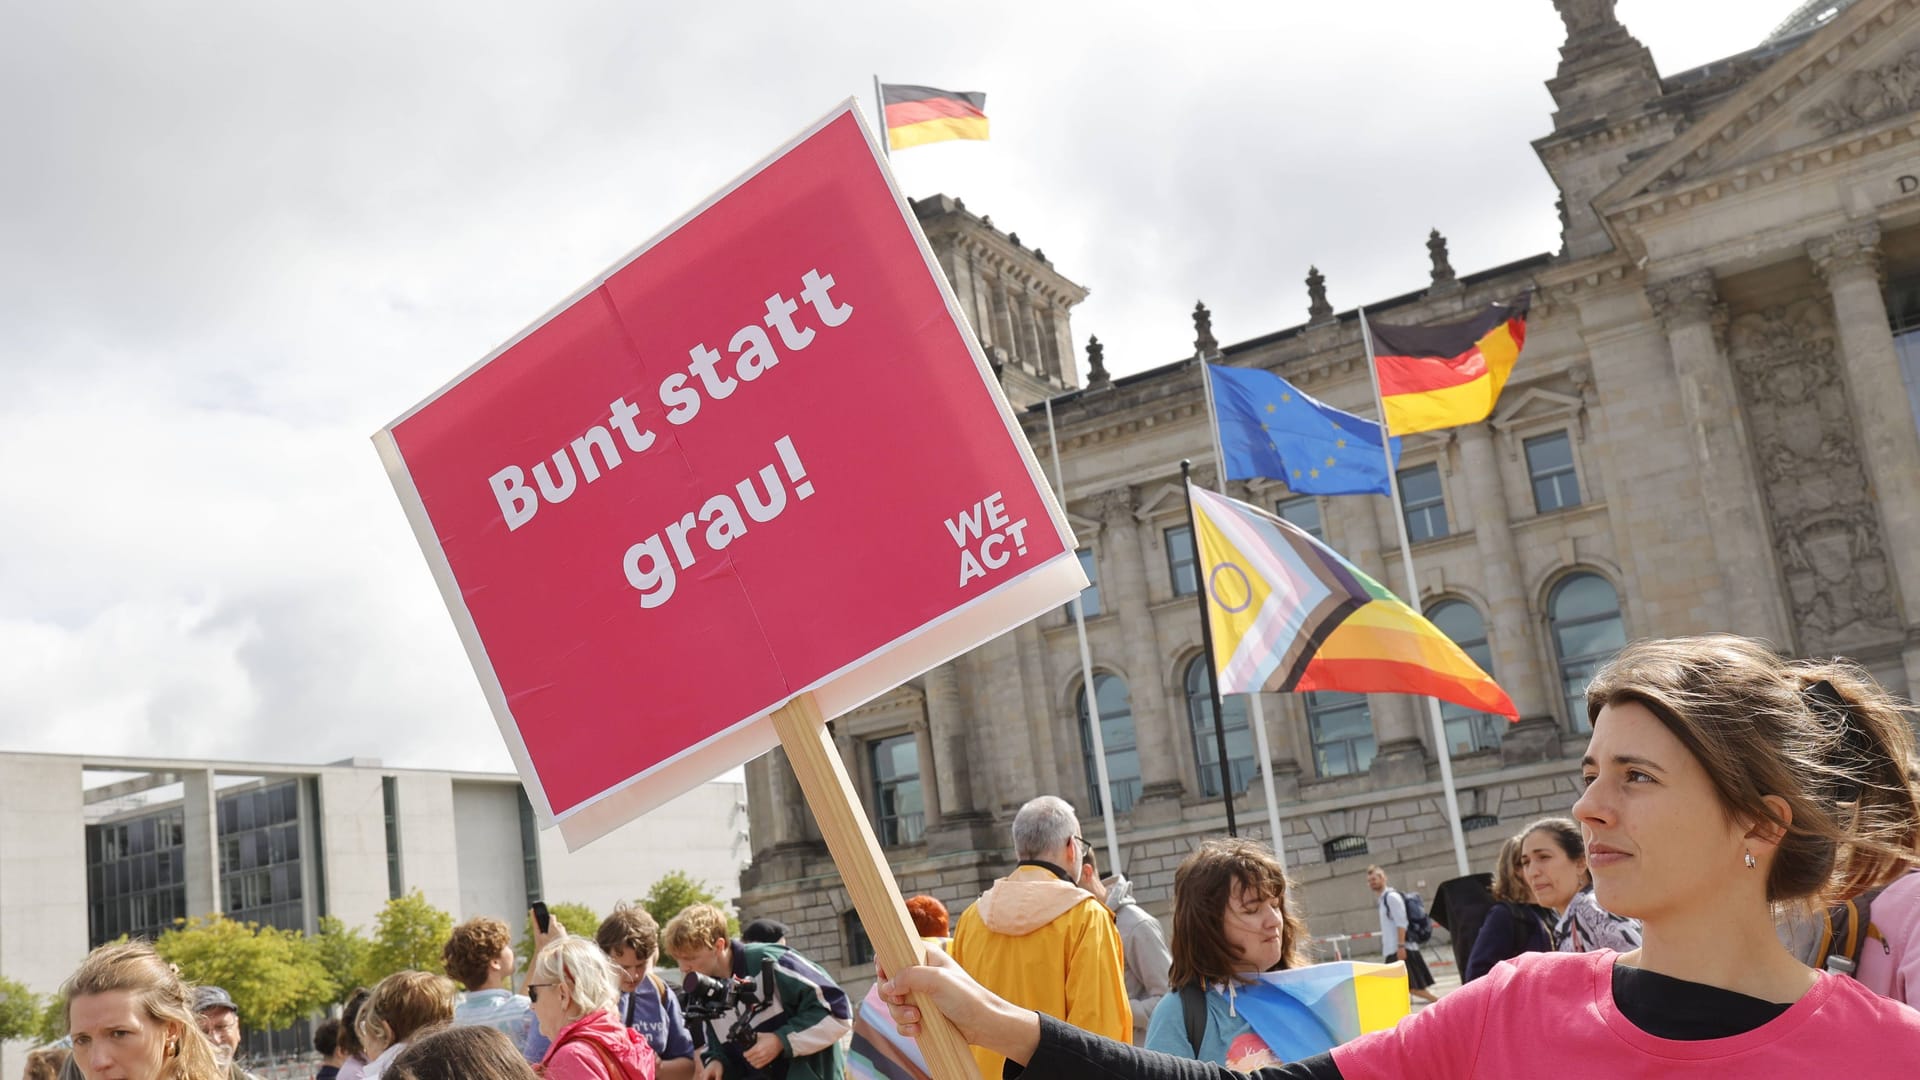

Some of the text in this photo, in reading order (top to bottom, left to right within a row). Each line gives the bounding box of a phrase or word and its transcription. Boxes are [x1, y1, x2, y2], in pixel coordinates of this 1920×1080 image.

[488, 269, 853, 531] Bunt statt
[623, 435, 815, 608] grau!
[944, 491, 1010, 548] WE
